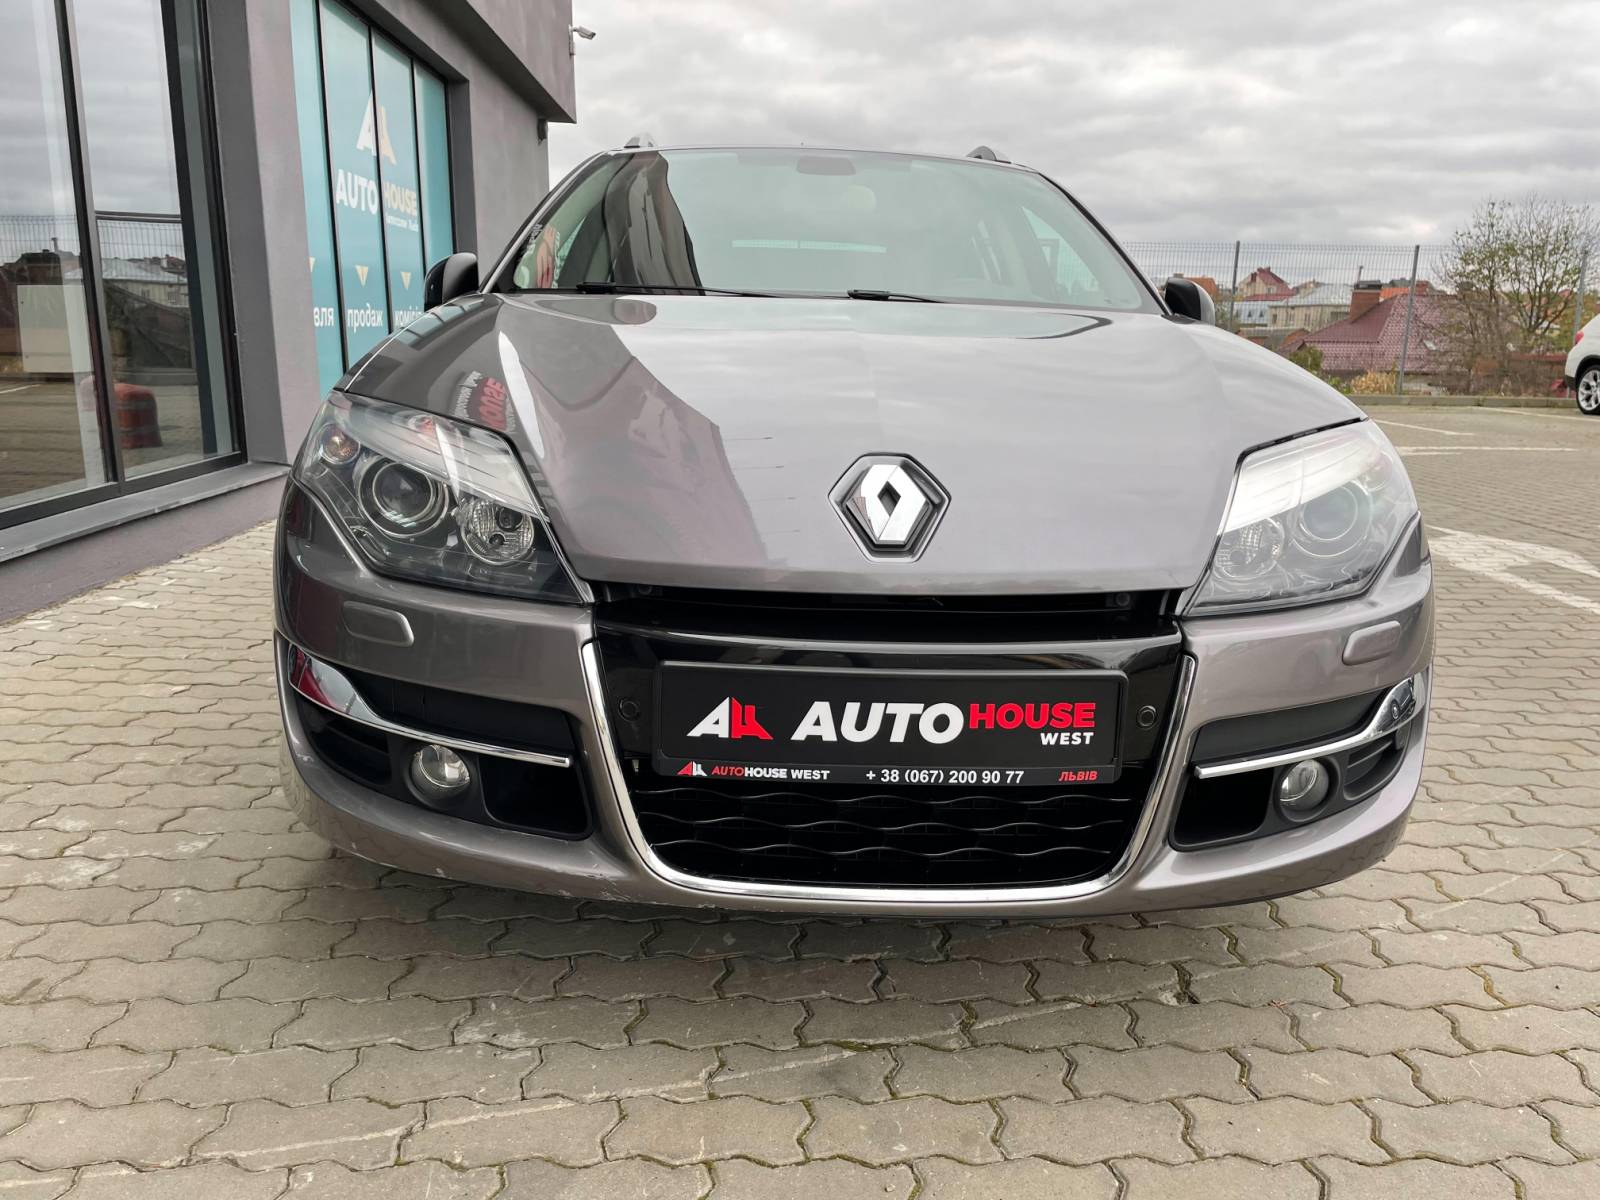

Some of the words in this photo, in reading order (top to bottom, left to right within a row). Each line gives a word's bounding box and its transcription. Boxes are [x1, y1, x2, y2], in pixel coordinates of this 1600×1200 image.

[336, 168, 379, 215] AUTO
[383, 181, 418, 217] HOUSE
[346, 302, 384, 334] продаж
[790, 700, 964, 744] AUTO
[968, 702, 1096, 729] HOUSE
[1040, 731, 1095, 746] WEST
[711, 765, 788, 779] AUTOHOUSE
[790, 769, 830, 780] WEST
[880, 769, 900, 783] 38
[904, 769, 944, 784] (067)
[949, 771, 978, 784] 200
[981, 770, 1001, 784] 90
[1005, 770, 1025, 784] 77
[1058, 770, 1099, 782] ЛЬВІВ
